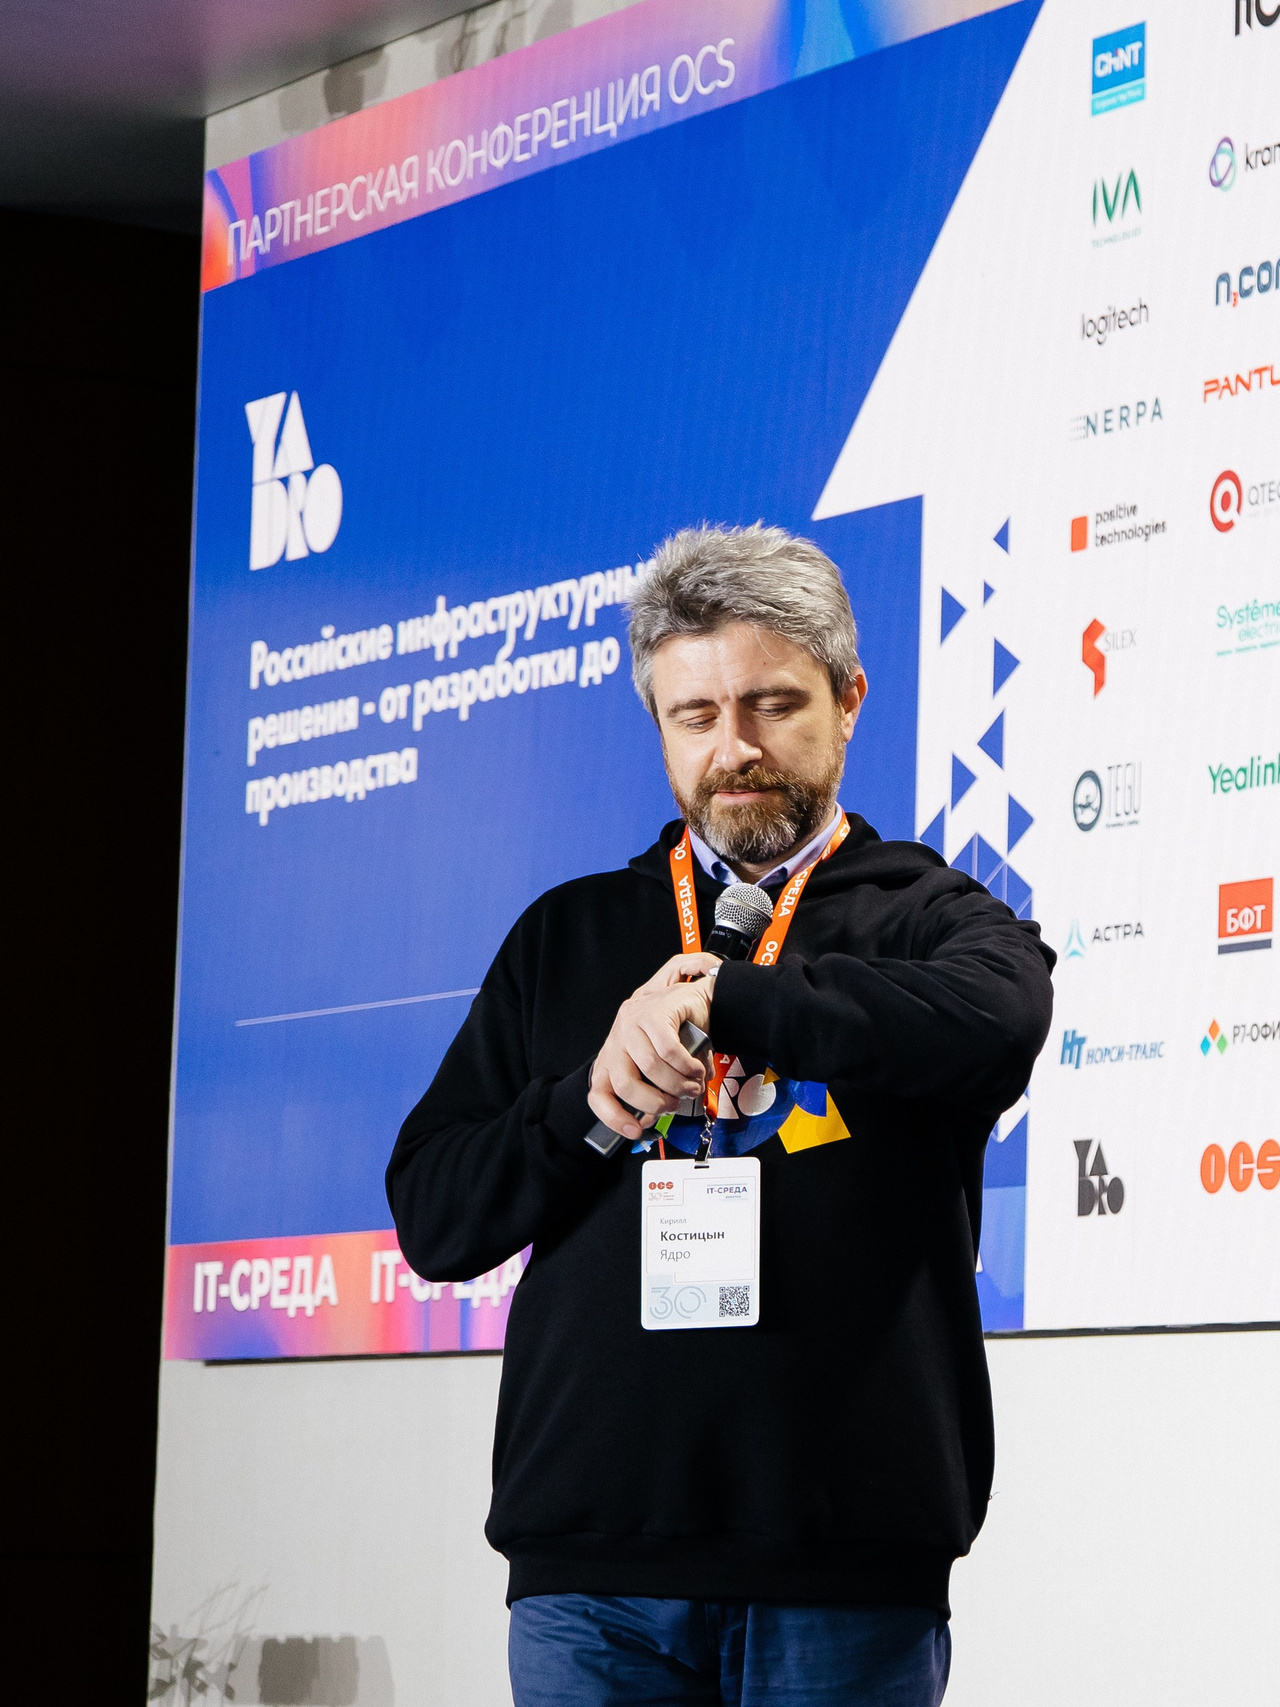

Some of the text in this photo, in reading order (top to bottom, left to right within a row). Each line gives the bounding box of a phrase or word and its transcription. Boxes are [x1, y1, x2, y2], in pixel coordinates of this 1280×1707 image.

[227, 37, 737, 267] ПАРТНЕРСКАЯ КОНФЕРЕНЦИЯ OCS
[1080, 298, 1150, 346] logitech
[1095, 503, 1139, 526] positive
[1094, 519, 1168, 548] technologies
[249, 557, 660, 690] Российские инфраструктурны
[1104, 629, 1138, 652] SILEX
[246, 695, 359, 767] решения
[378, 684, 412, 724] от
[412, 645, 578, 732] разработки
[578, 636, 621, 688] до
[245, 747, 419, 827] производства
[677, 875, 697, 946] IT-СРЕДА
[1225, 904, 1267, 935] БФТ
[1091, 921, 1145, 943] АСТРА
[760, 940, 779, 966] OC
[1086, 1041, 1165, 1065] НОРСИ-ТРАНС
[648, 1181, 674, 1190] OCS
[706, 1186, 748, 1195] IT-СРЕДА
[659, 1218, 687, 1226] Кирилл
[660, 1230, 725, 1242] Костицын
[660, 1249, 691, 1262] Ядро
[193, 1254, 339, 1318] IT-СРЕДА
[649, 1285, 707, 1320] 30
